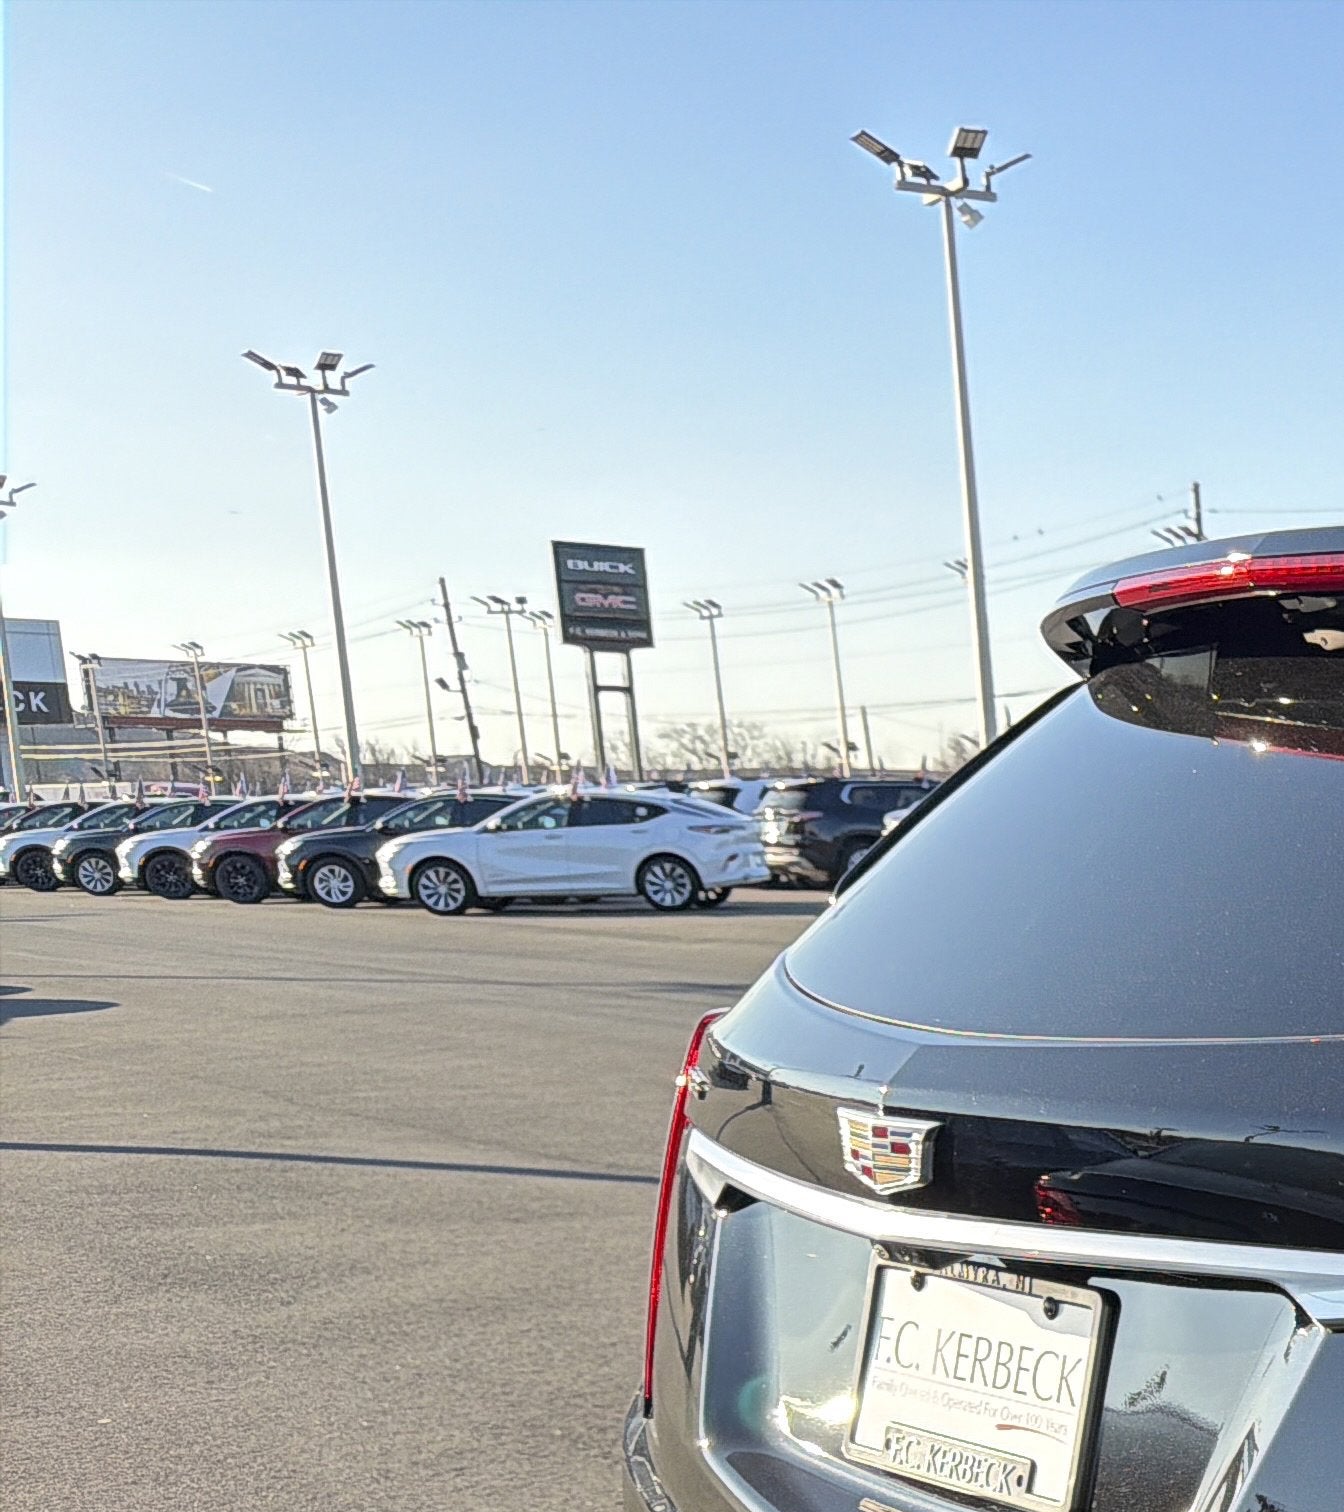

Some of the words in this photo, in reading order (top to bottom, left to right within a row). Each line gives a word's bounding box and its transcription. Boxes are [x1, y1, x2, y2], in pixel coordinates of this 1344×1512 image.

[566, 559, 637, 575] BUICK
[574, 592, 637, 610] GMC
[0, 690, 50, 713] CK
[873, 1316, 921, 1371] F.C.
[931, 1328, 1083, 1408] KERBECK
[926, 1443, 1017, 1496] KERBECK
